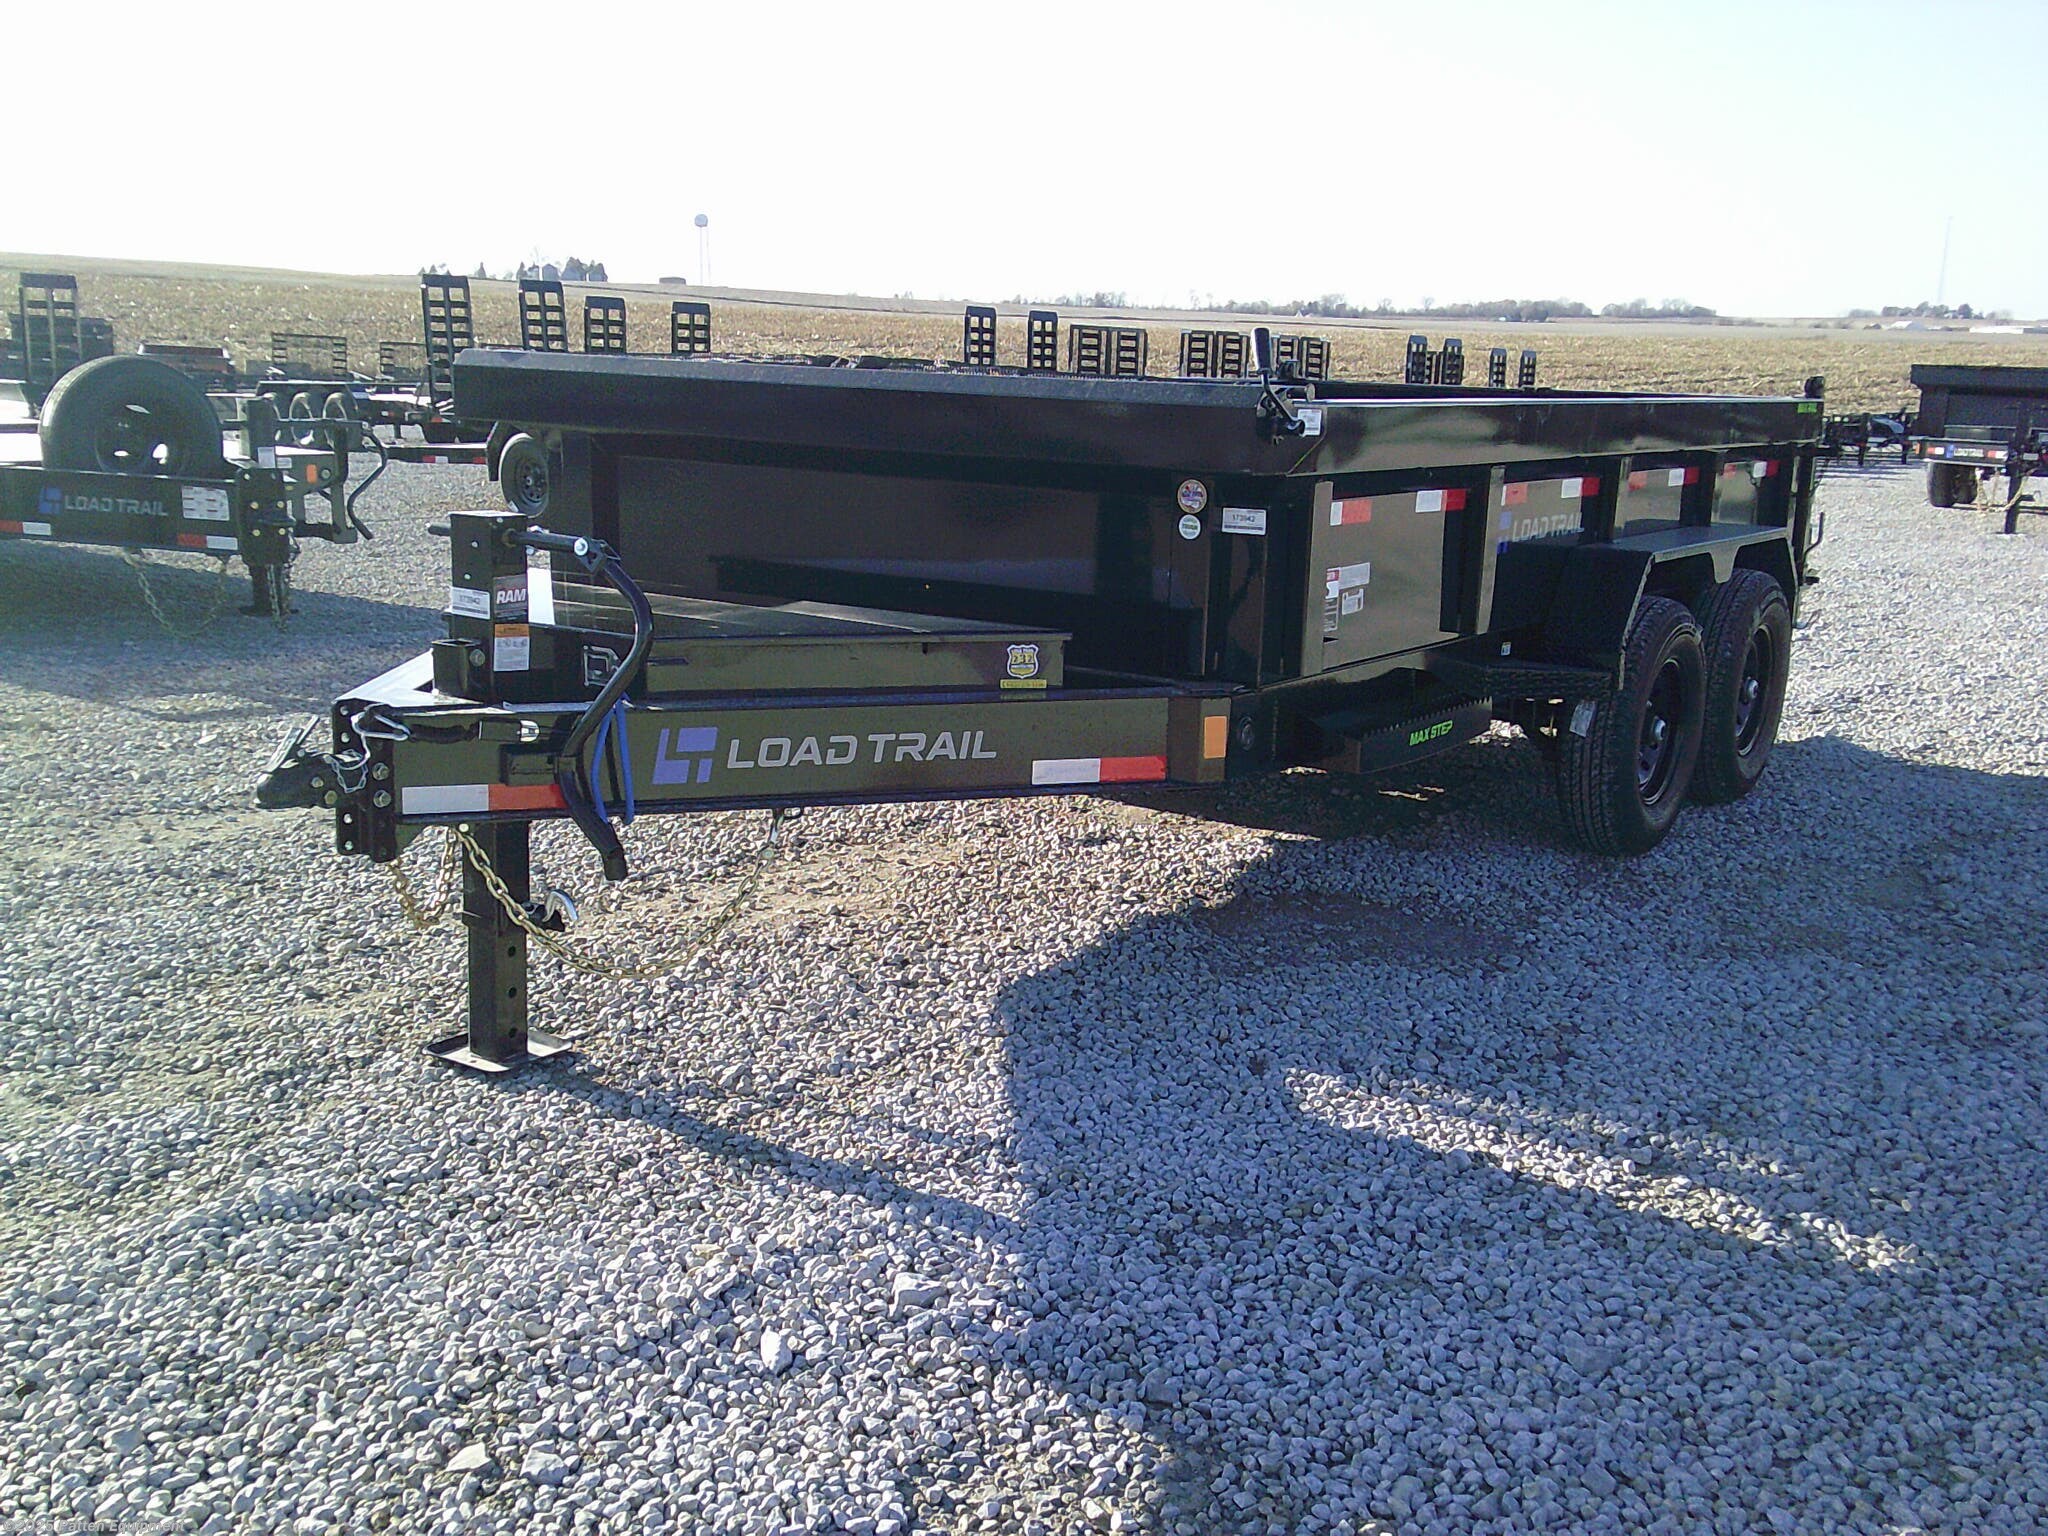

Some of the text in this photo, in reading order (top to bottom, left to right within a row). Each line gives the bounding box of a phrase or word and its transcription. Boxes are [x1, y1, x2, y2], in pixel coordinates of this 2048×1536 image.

[64, 495, 112, 512] LOAD
[115, 498, 168, 516] TRAIL
[1511, 511, 1585, 542] LOAD TRAIL
[496, 588, 527, 604] RAM
[1409, 719, 1453, 746] MAX STEP
[727, 730, 997, 769] LOAD TRAIL
